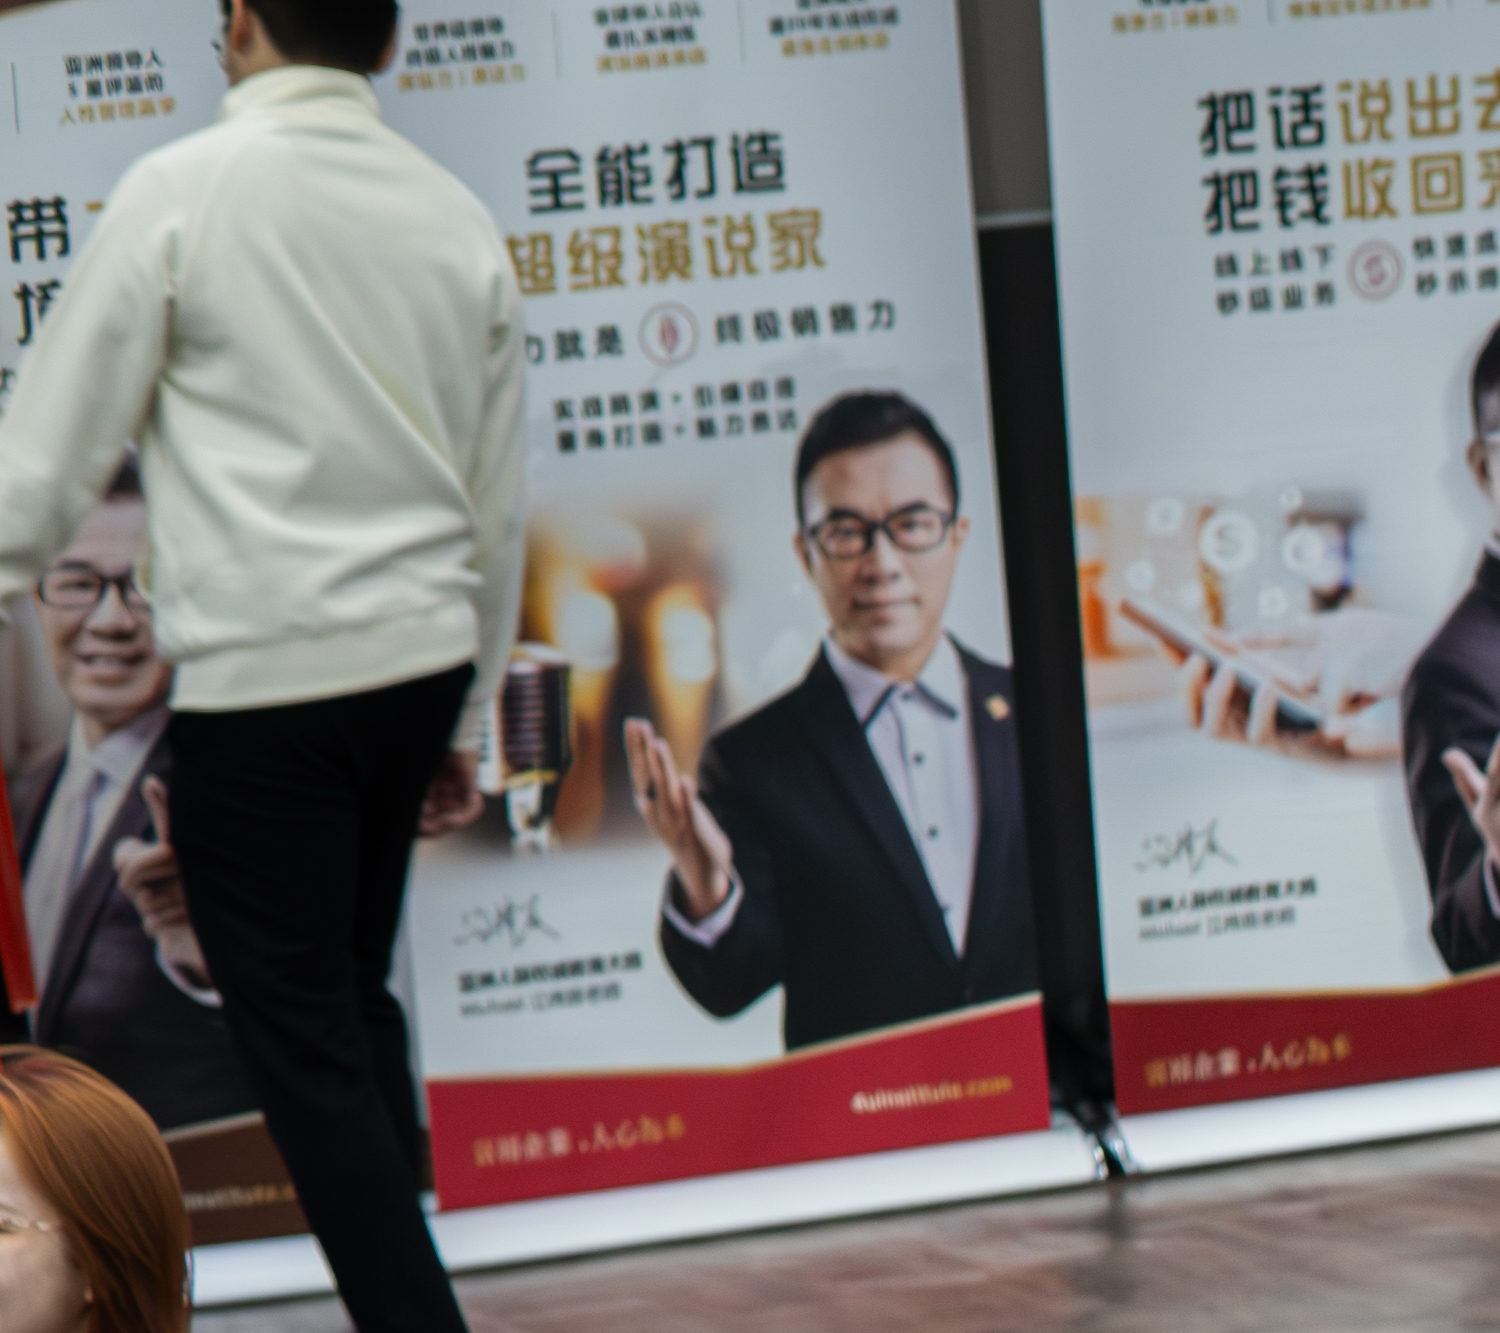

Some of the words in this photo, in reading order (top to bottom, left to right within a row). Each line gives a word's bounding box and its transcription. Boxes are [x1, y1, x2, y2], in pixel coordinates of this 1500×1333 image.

[525, 129, 786, 215] 全能打造
[506, 207, 828, 297] 超级演说家
[1214, 245, 1334, 278] 线上线下
